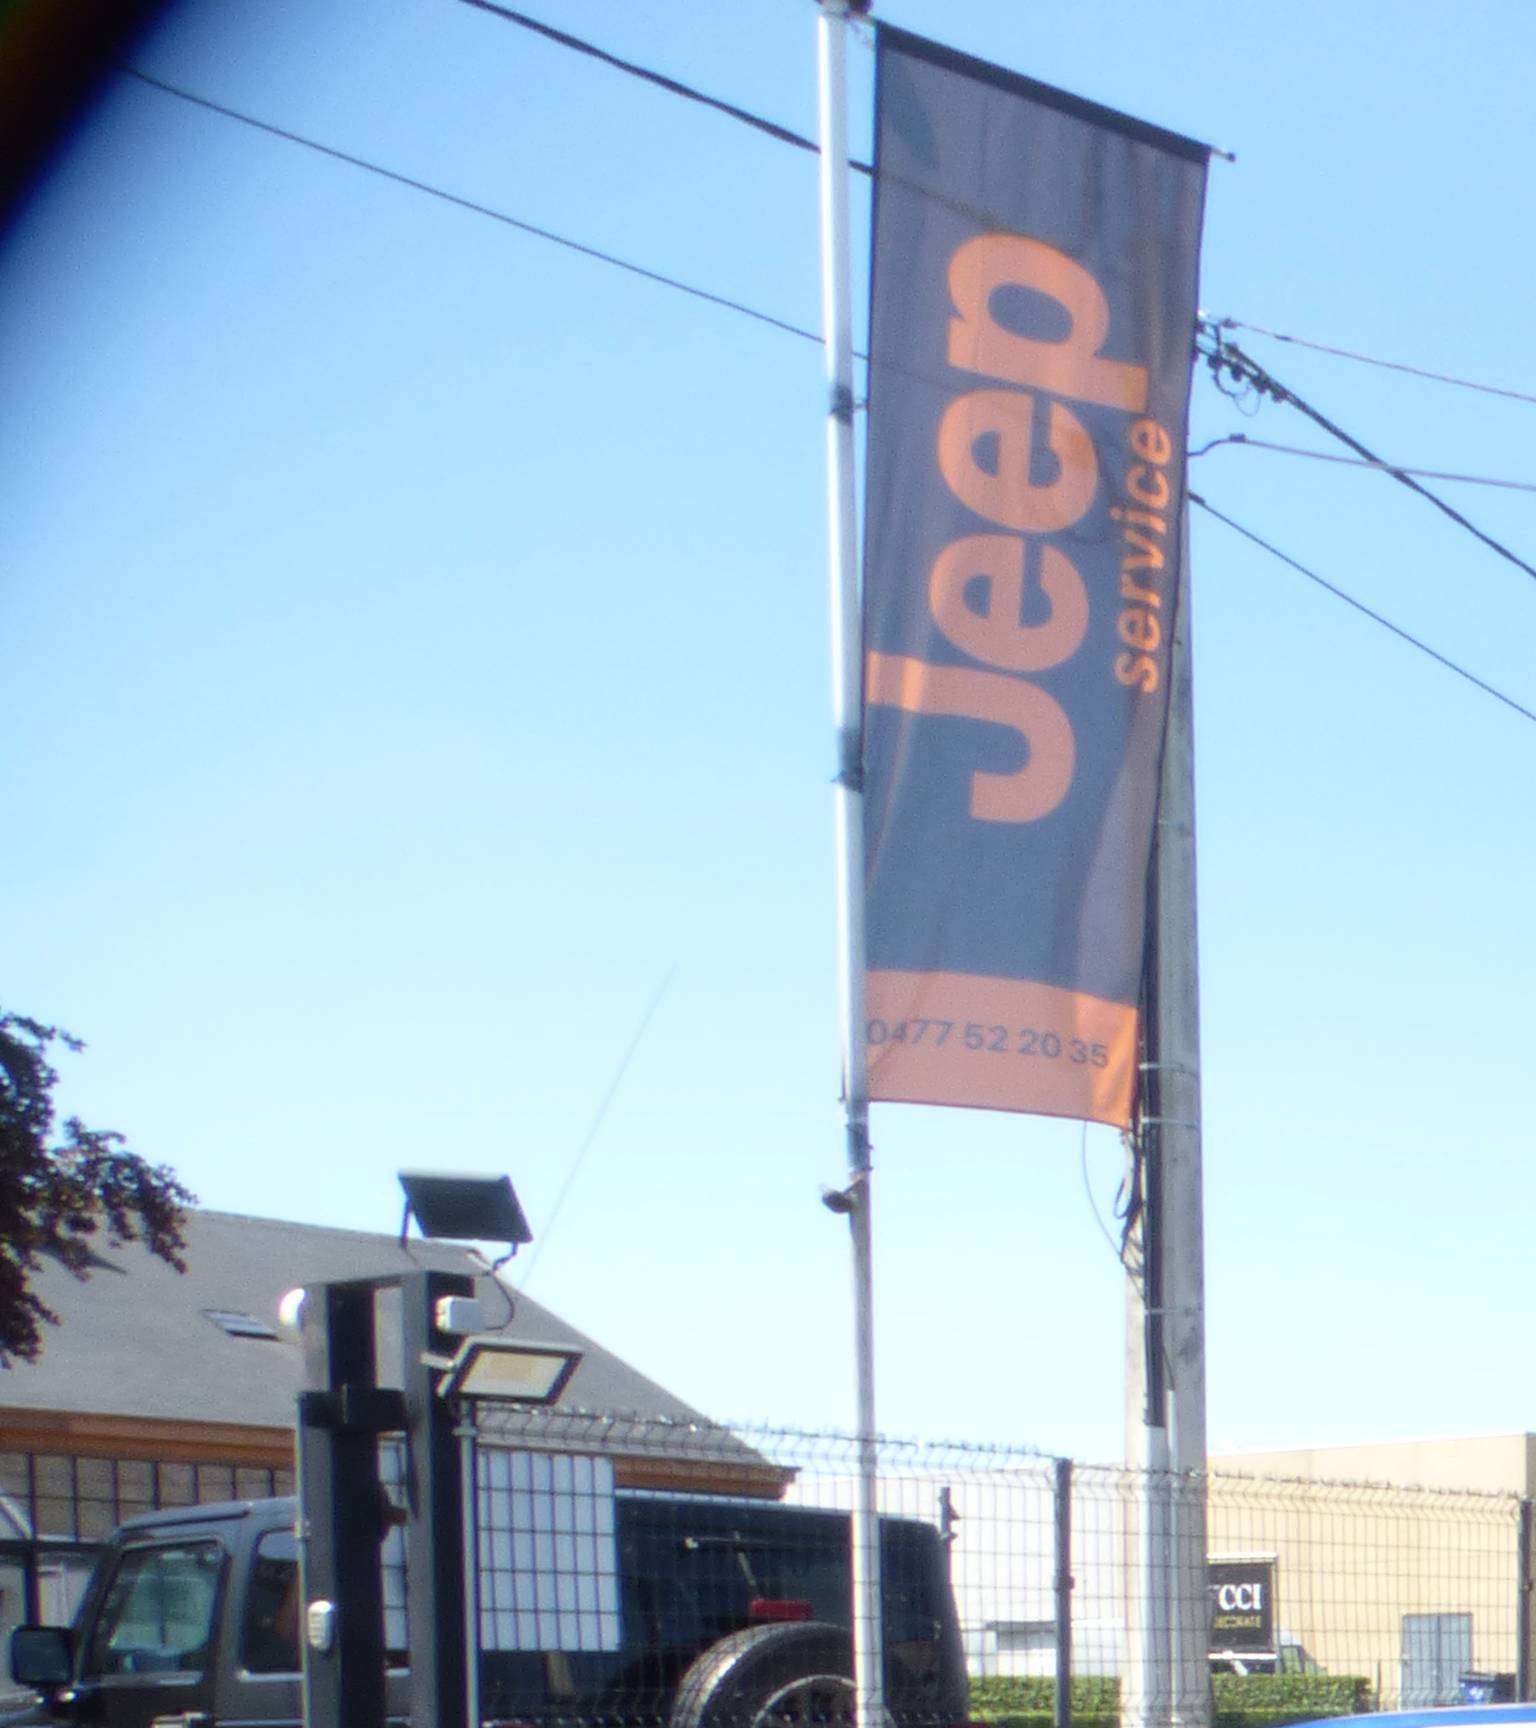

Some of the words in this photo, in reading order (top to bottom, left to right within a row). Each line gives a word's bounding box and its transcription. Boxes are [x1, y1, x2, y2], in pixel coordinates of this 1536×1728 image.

[867, 232, 1148, 823] Jeep
[1113, 419, 1170, 693] service
[866, 1018, 953, 1047] 0477
[963, 1023, 1008, 1052] 52
[1018, 1028, 1062, 1058] 20
[1069, 1035, 1109, 1068] 35
